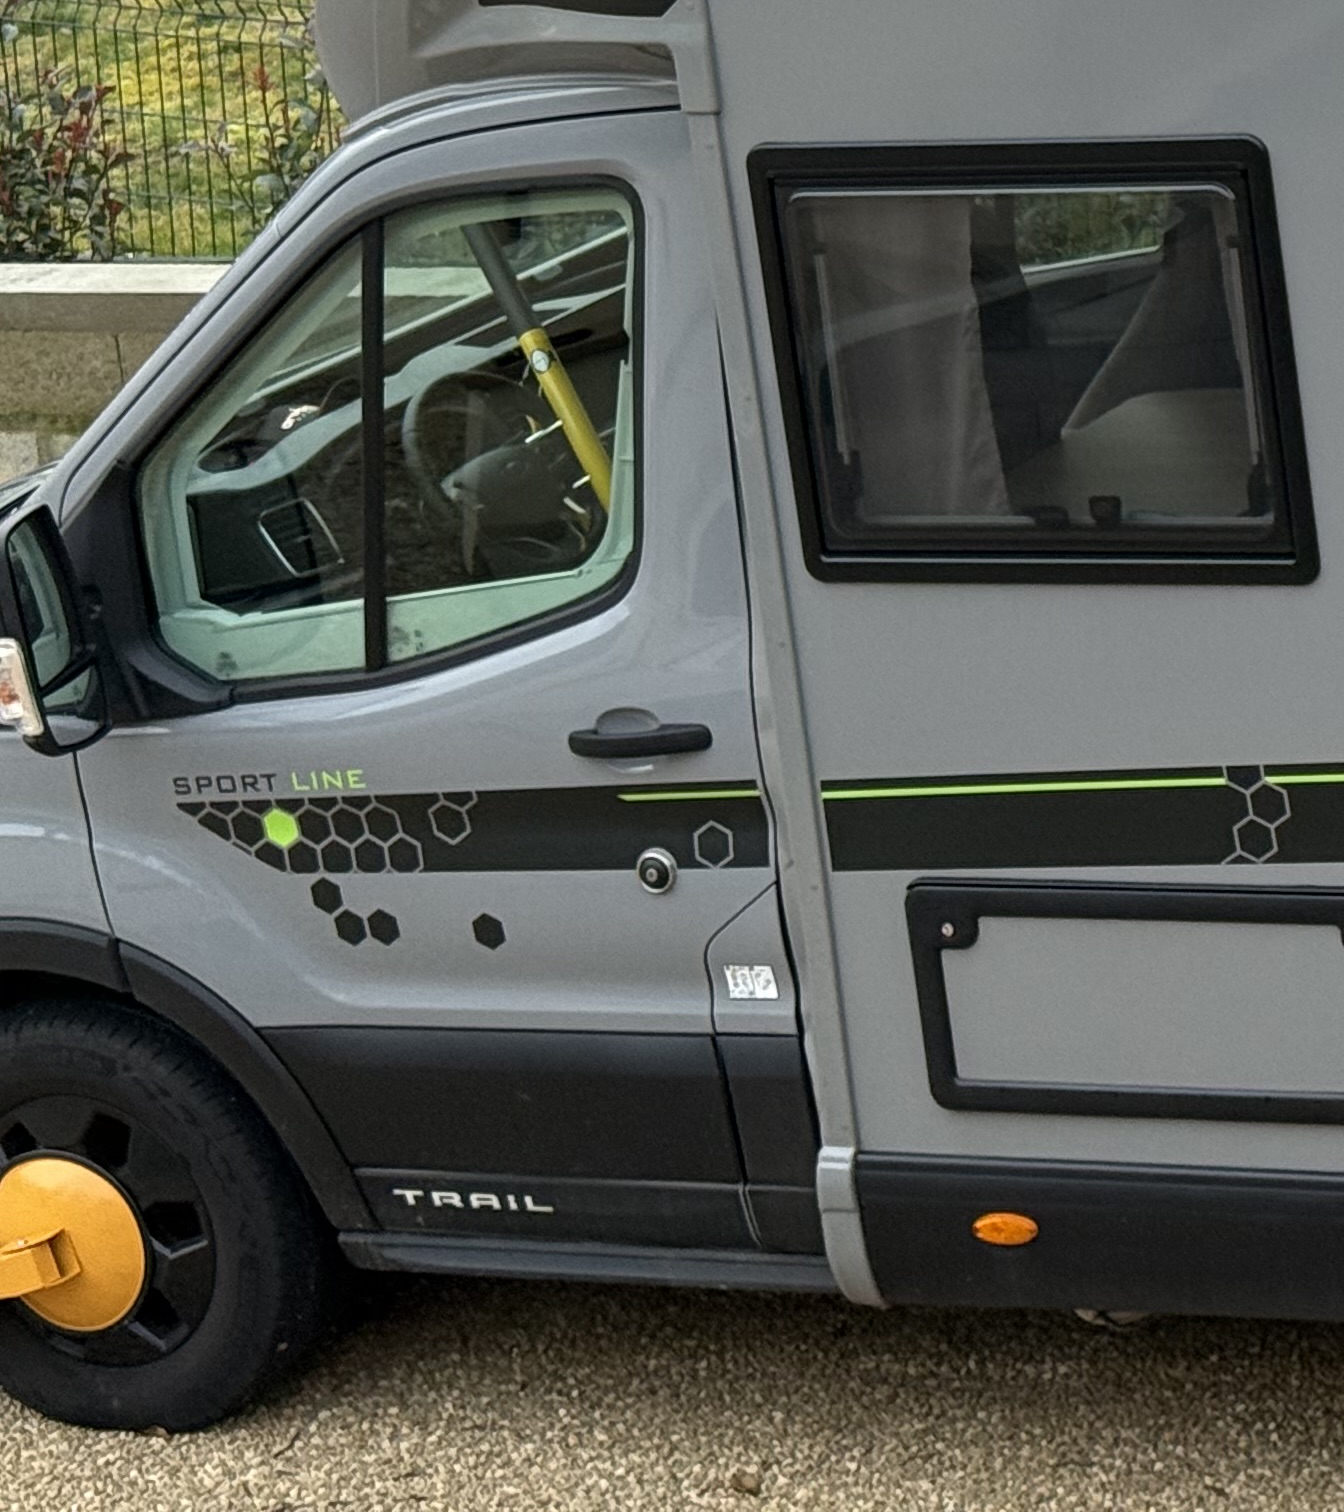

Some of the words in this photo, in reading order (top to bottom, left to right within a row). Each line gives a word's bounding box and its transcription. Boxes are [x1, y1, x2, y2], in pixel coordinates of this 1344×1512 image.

[173, 773, 277, 795] SPORT
[291, 769, 367, 791] LINE
[392, 1188, 554, 1213] TRAIL
